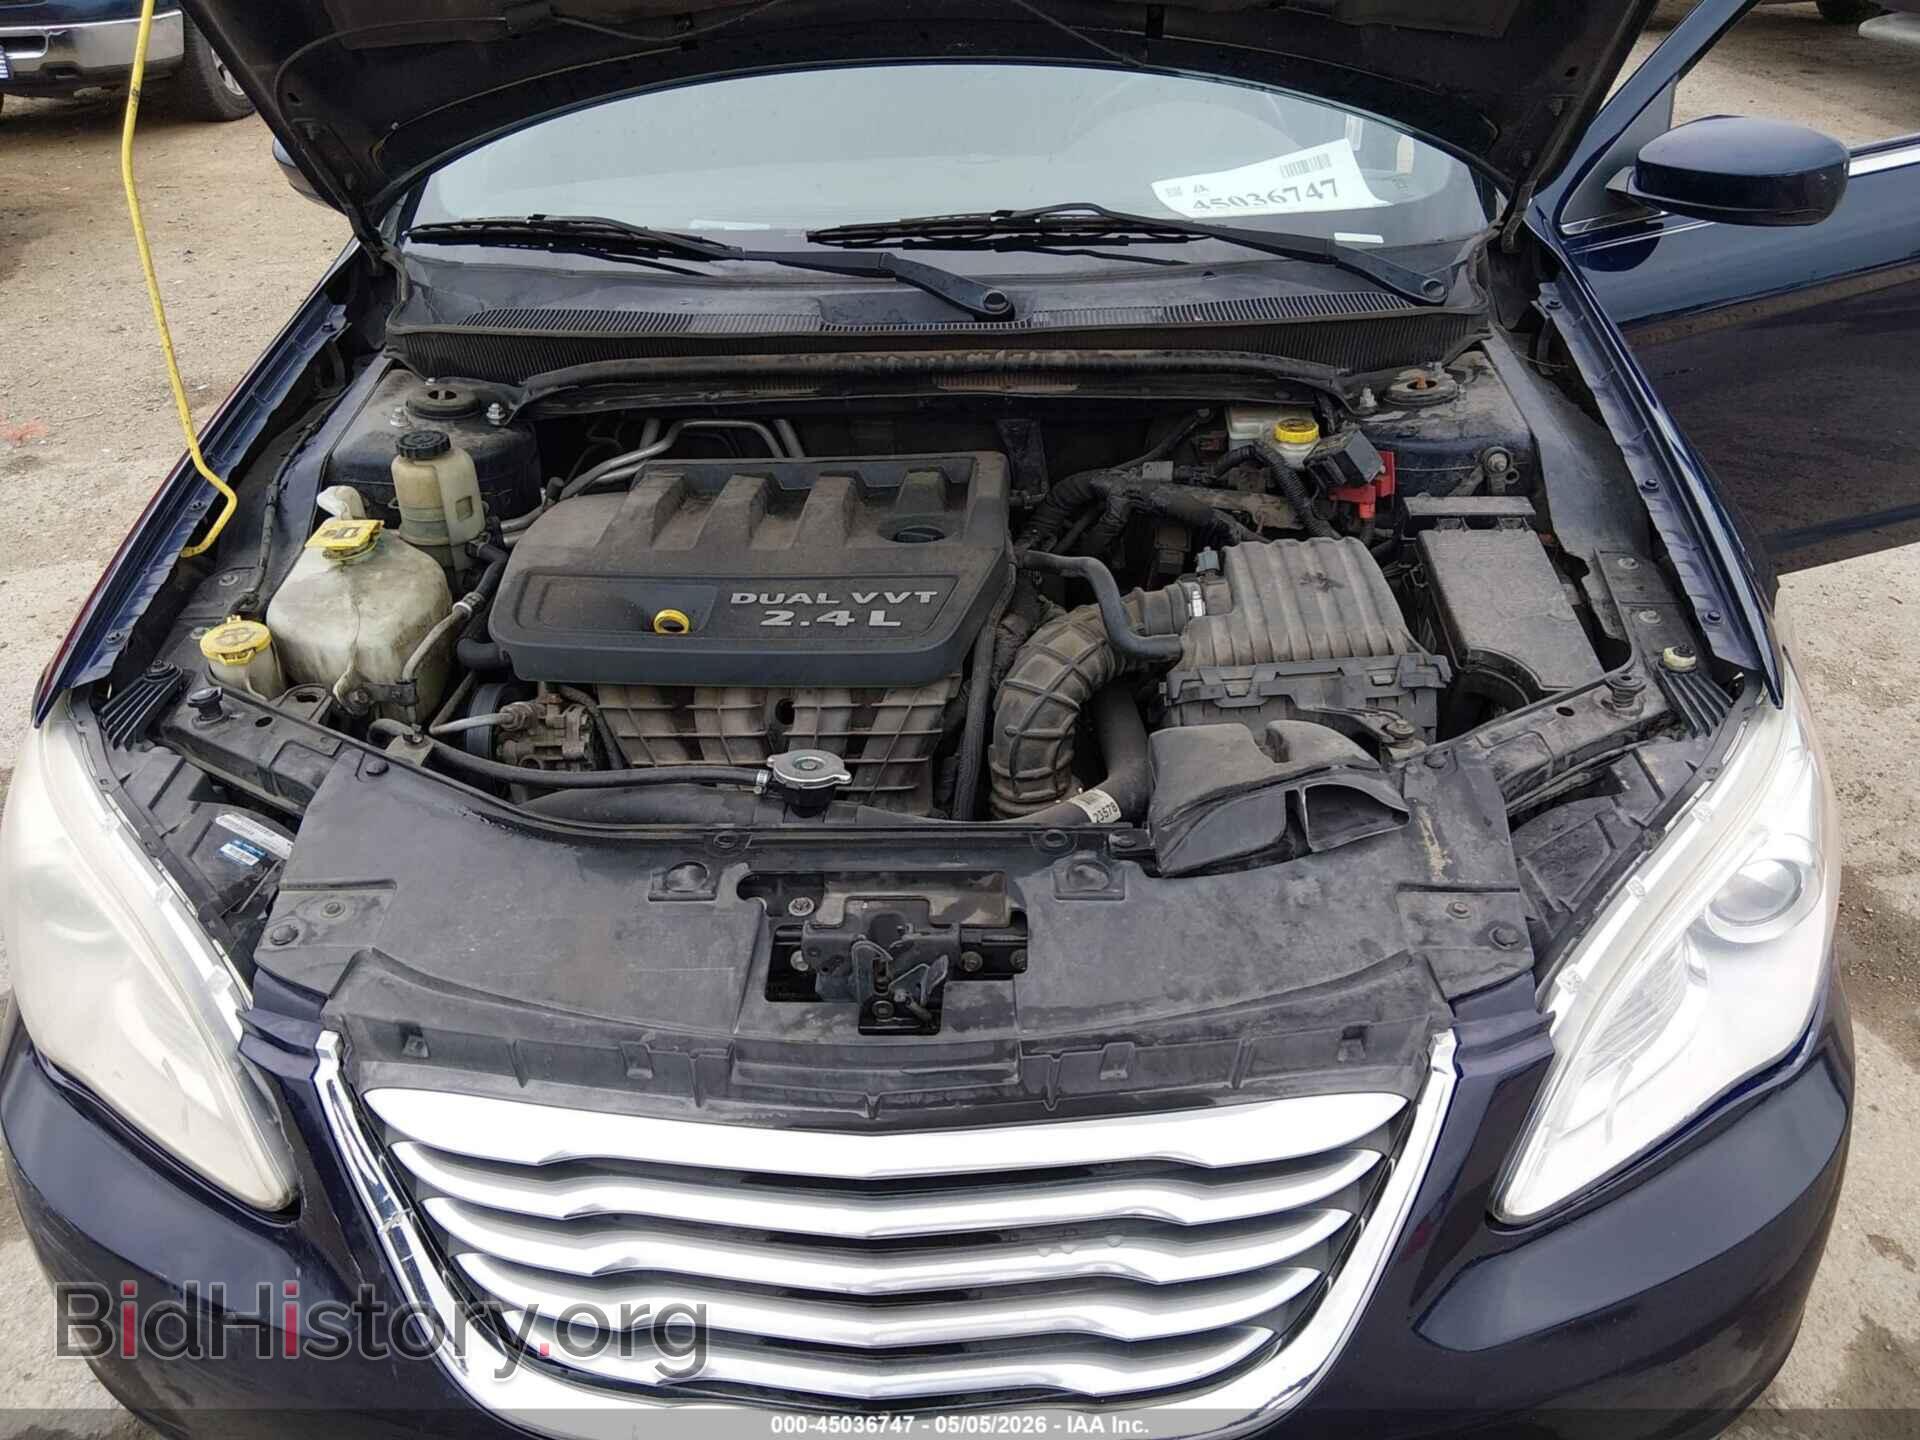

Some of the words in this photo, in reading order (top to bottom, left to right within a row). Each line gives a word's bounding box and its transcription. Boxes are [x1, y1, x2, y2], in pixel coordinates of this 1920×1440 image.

[1193, 178, 1338, 209] 45036747
[730, 592, 840, 604] DUAL
[851, 591, 938, 604] VVT
